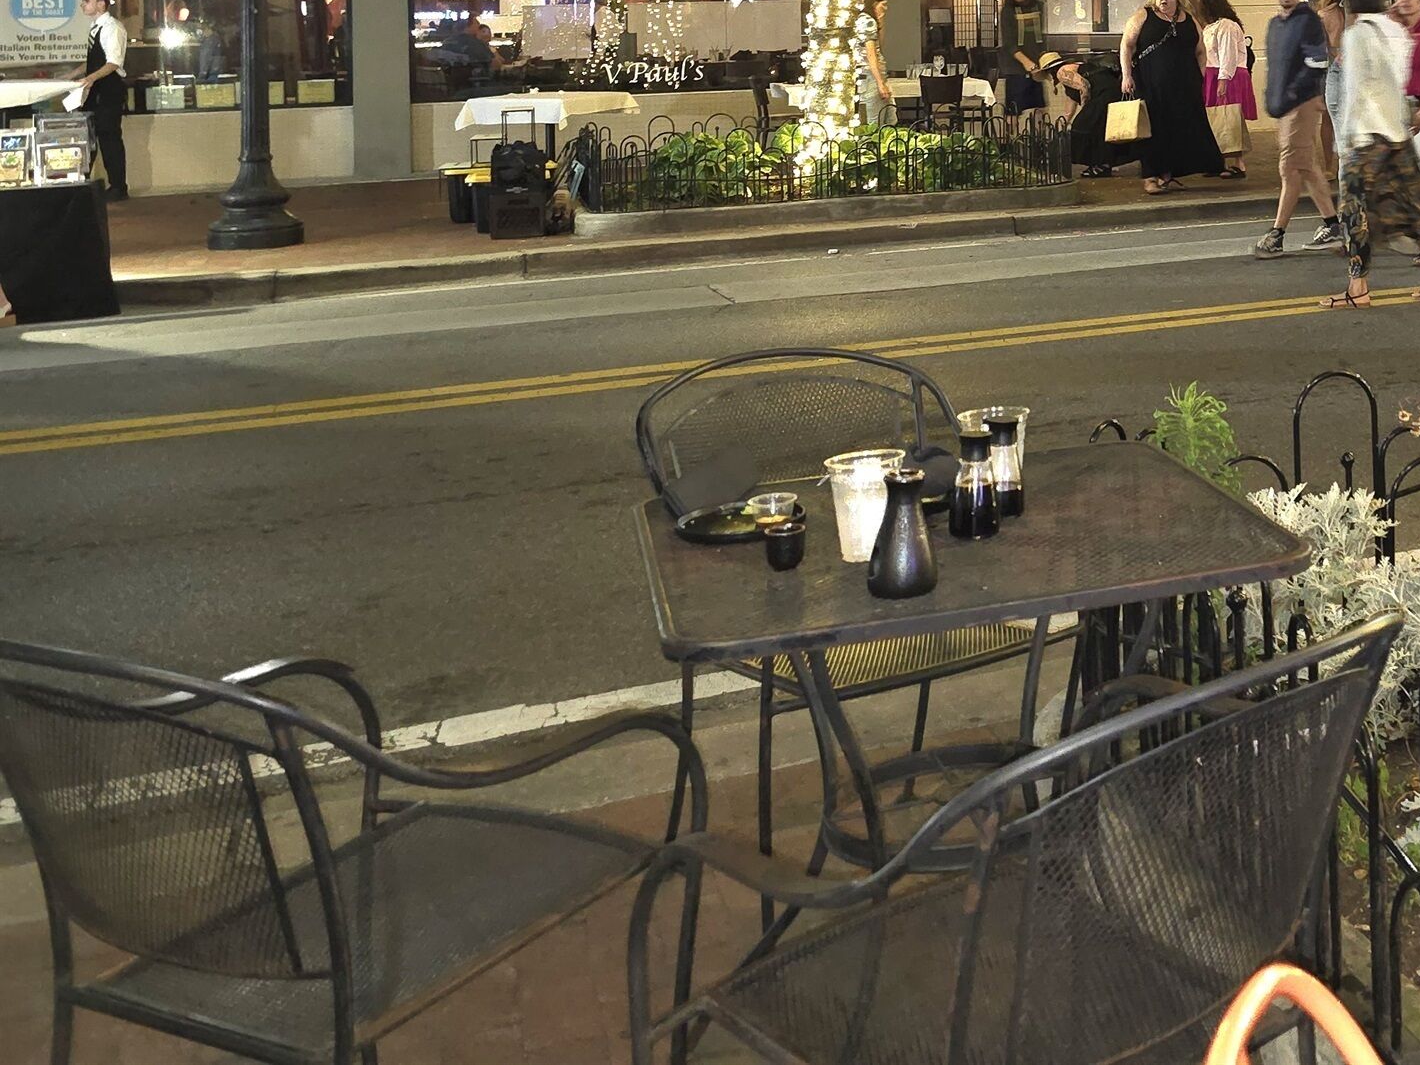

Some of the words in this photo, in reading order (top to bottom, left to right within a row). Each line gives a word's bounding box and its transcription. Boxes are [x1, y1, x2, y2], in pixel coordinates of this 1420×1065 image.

[16, 34, 45, 42] Voted
[49, 33, 72, 41] Best
[0, 43, 30, 52] Italian
[34, 42, 88, 51] Restaurant
[19, 53, 46, 61] Years
[626, 54, 705, 84] Paul's
